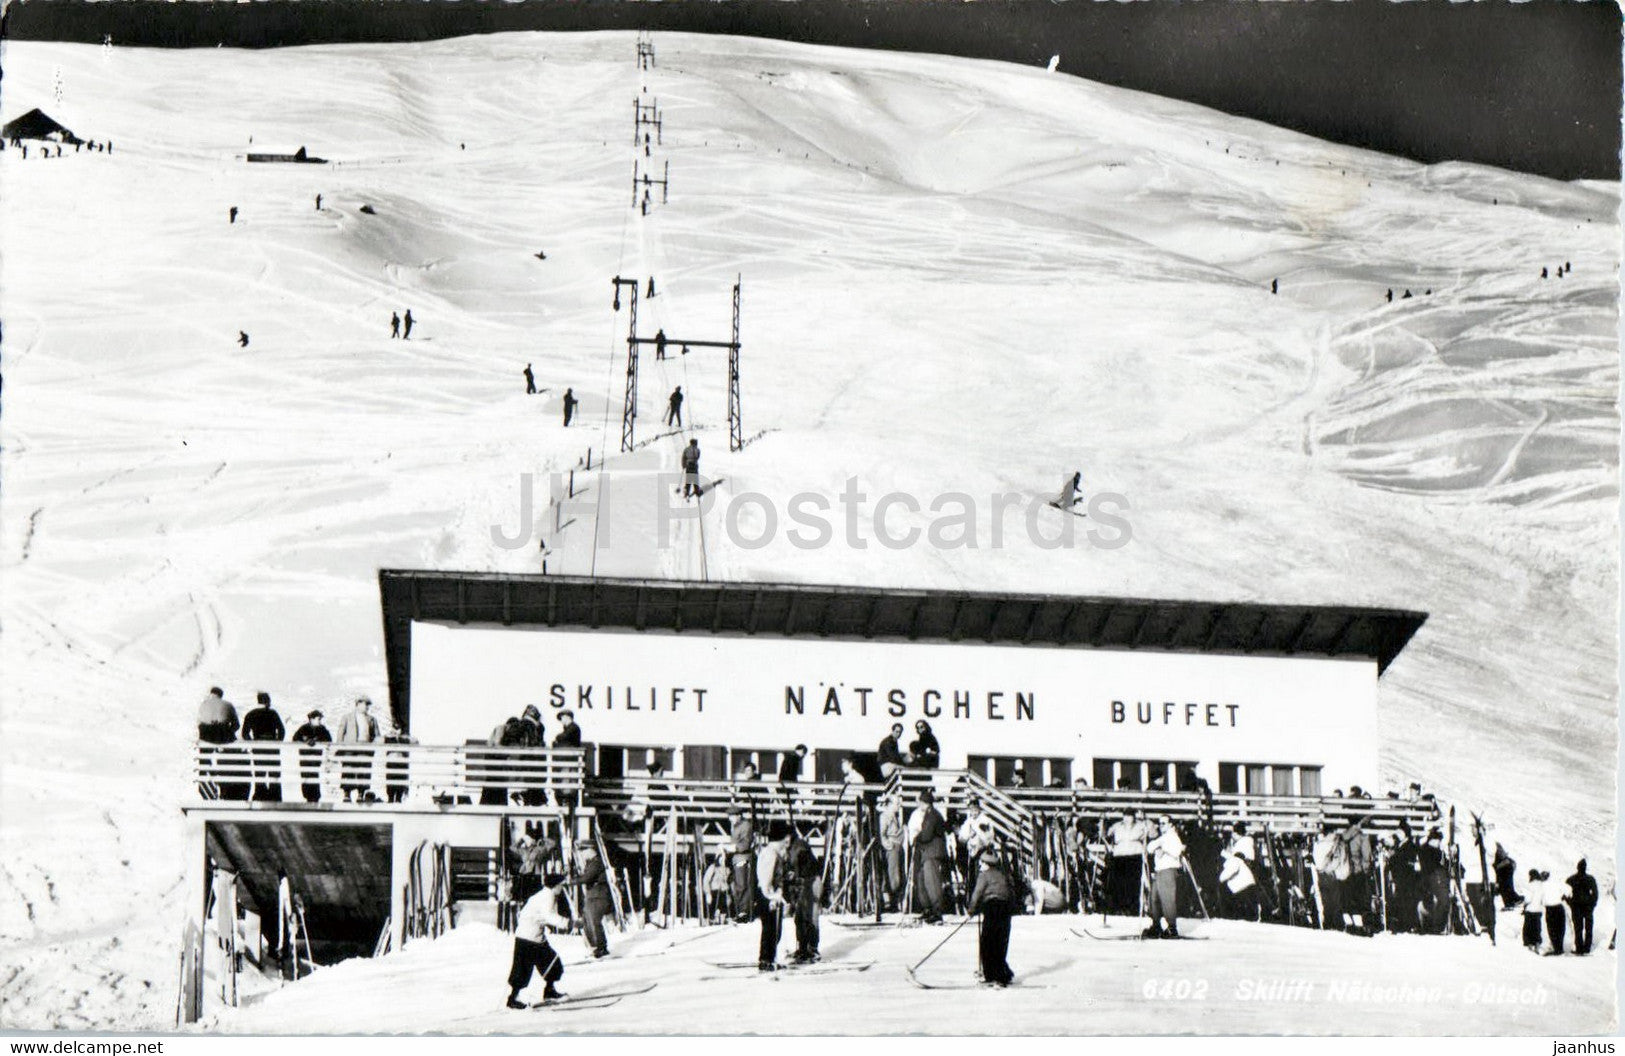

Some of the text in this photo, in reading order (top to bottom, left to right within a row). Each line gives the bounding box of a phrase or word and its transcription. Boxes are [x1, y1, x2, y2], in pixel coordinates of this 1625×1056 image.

[550, 682, 1240, 727] SKILIFT NÄTSCHEN BUFFET
